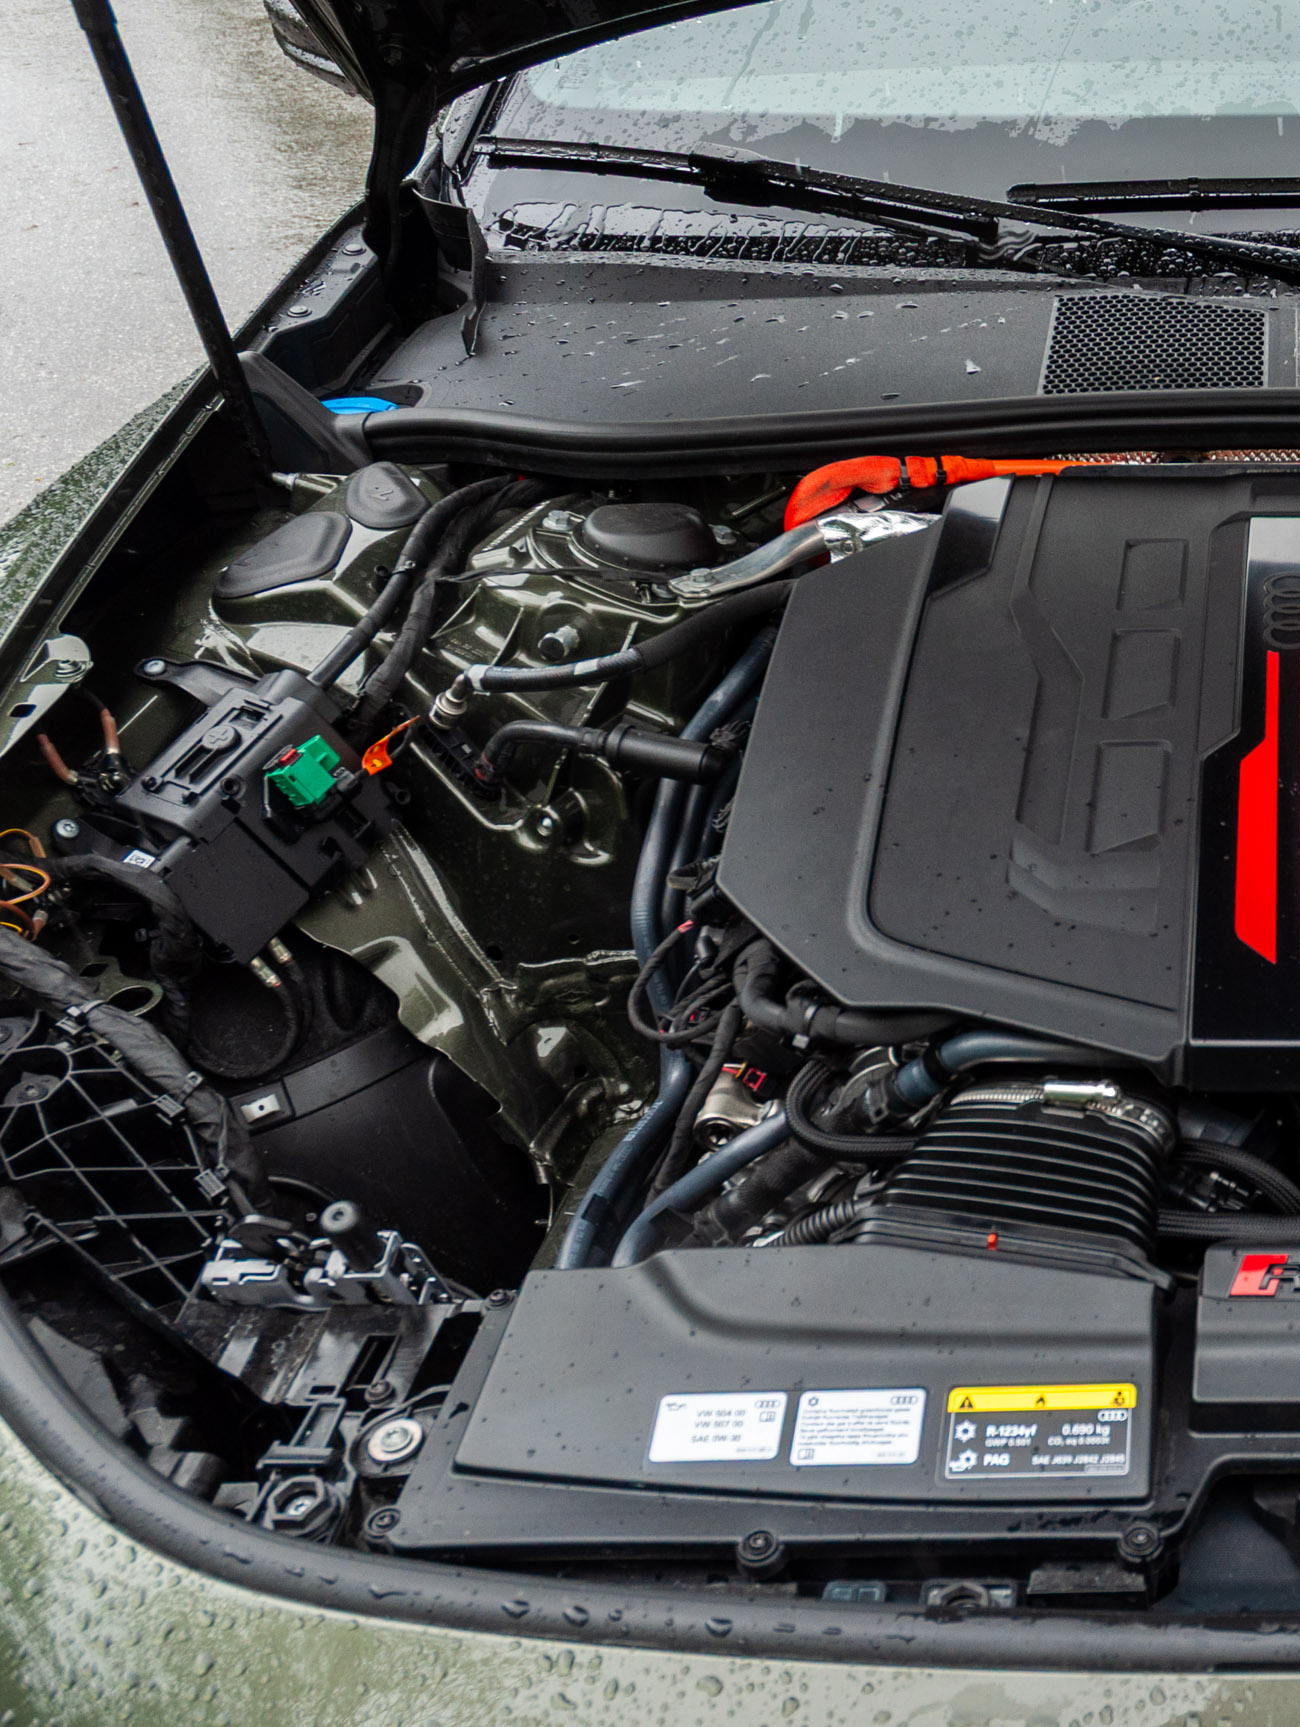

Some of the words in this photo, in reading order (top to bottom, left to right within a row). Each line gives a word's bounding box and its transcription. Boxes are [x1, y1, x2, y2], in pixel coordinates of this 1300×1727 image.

[985, 1423, 1038, 1438] R-1234yf
[1061, 1422, 1095, 1436] 0.690
[1096, 1422, 1111, 1438] kg
[982, 1452, 1010, 1467] PAG
